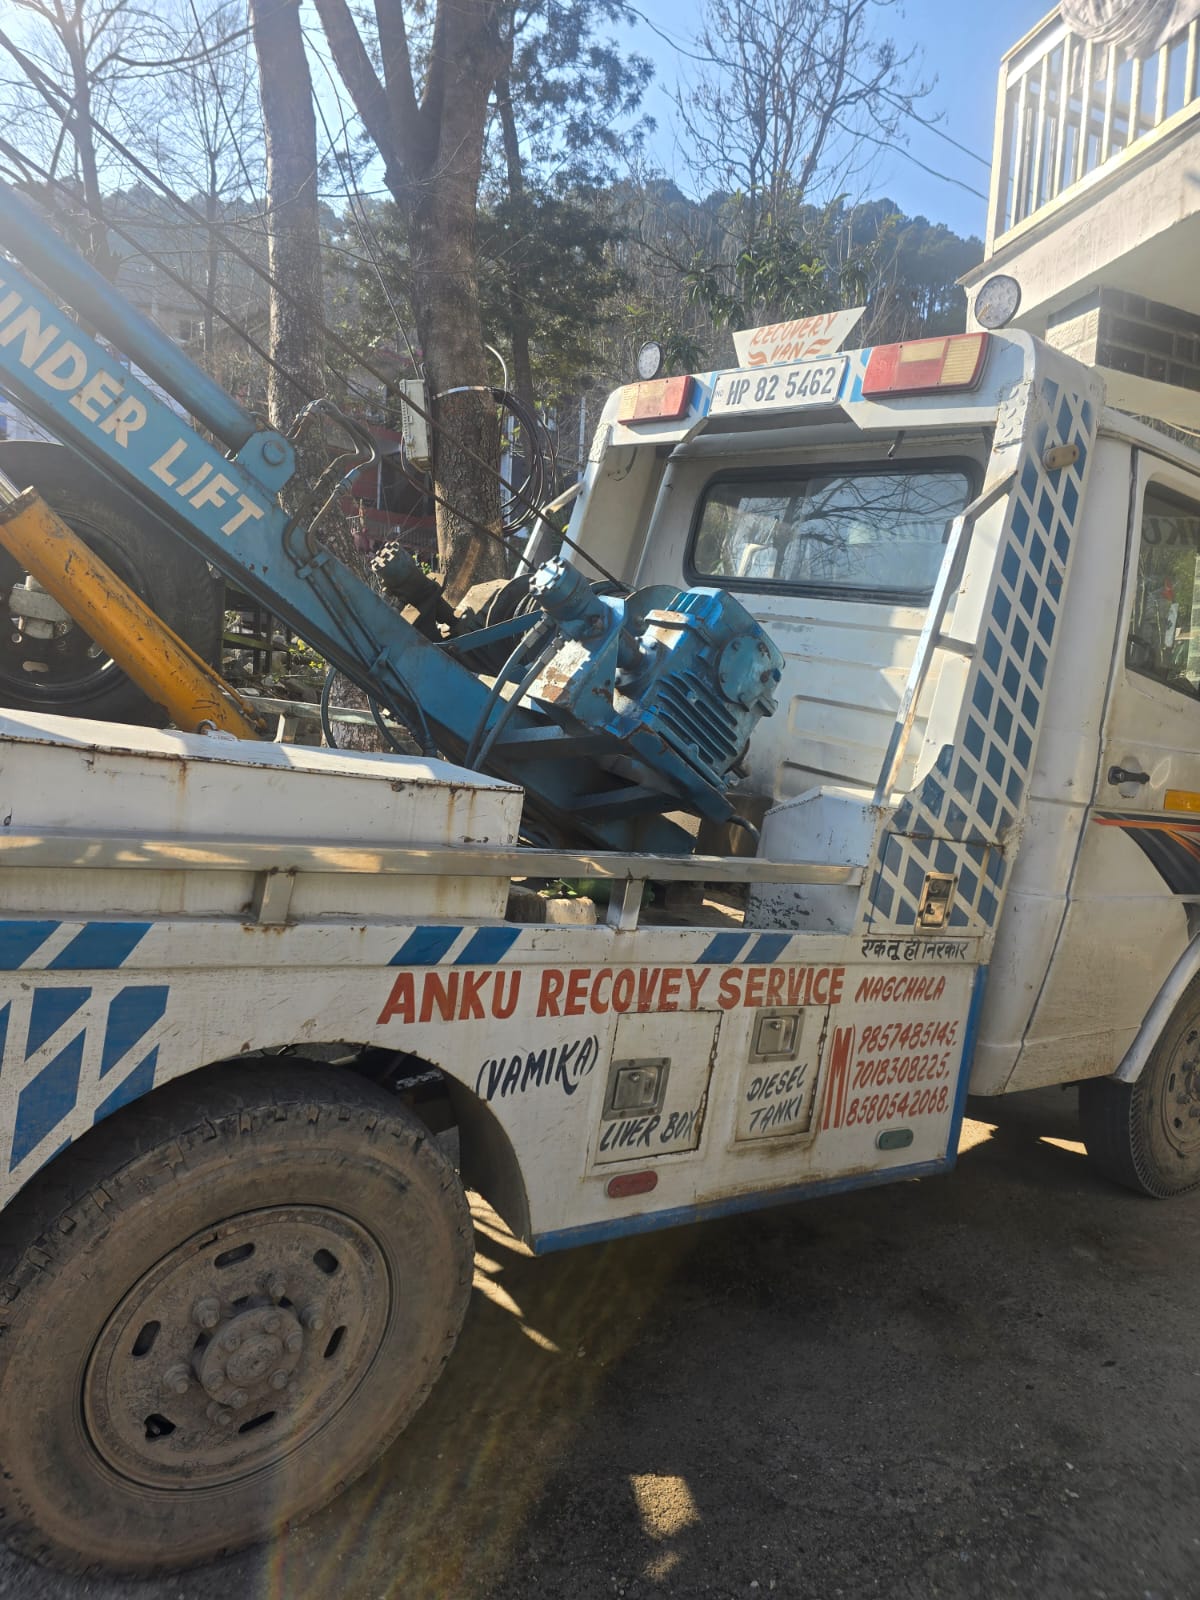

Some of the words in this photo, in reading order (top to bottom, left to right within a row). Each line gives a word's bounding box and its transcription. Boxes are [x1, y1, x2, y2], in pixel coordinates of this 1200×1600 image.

[750, 312, 838, 346] RECOVERY
[771, 341, 804, 361] VAN
[726, 379, 750, 405] HP
[755, 374, 779, 402] 82
[785, 367, 836, 398] 5462
[0, 279, 147, 448] INDER
[149, 438, 264, 536] LIFT
[376, 970, 521, 1024] ANKU
[536, 967, 711, 1017] RECOVEY
[717, 967, 845, 1010] SERVICE
[854, 975, 946, 1003] NAGCHALA
[475, 1034, 599, 1100] (VAMIKA)
[746, 1063, 808, 1102] DIESEL
[599, 1114, 661, 1152] LIVER
